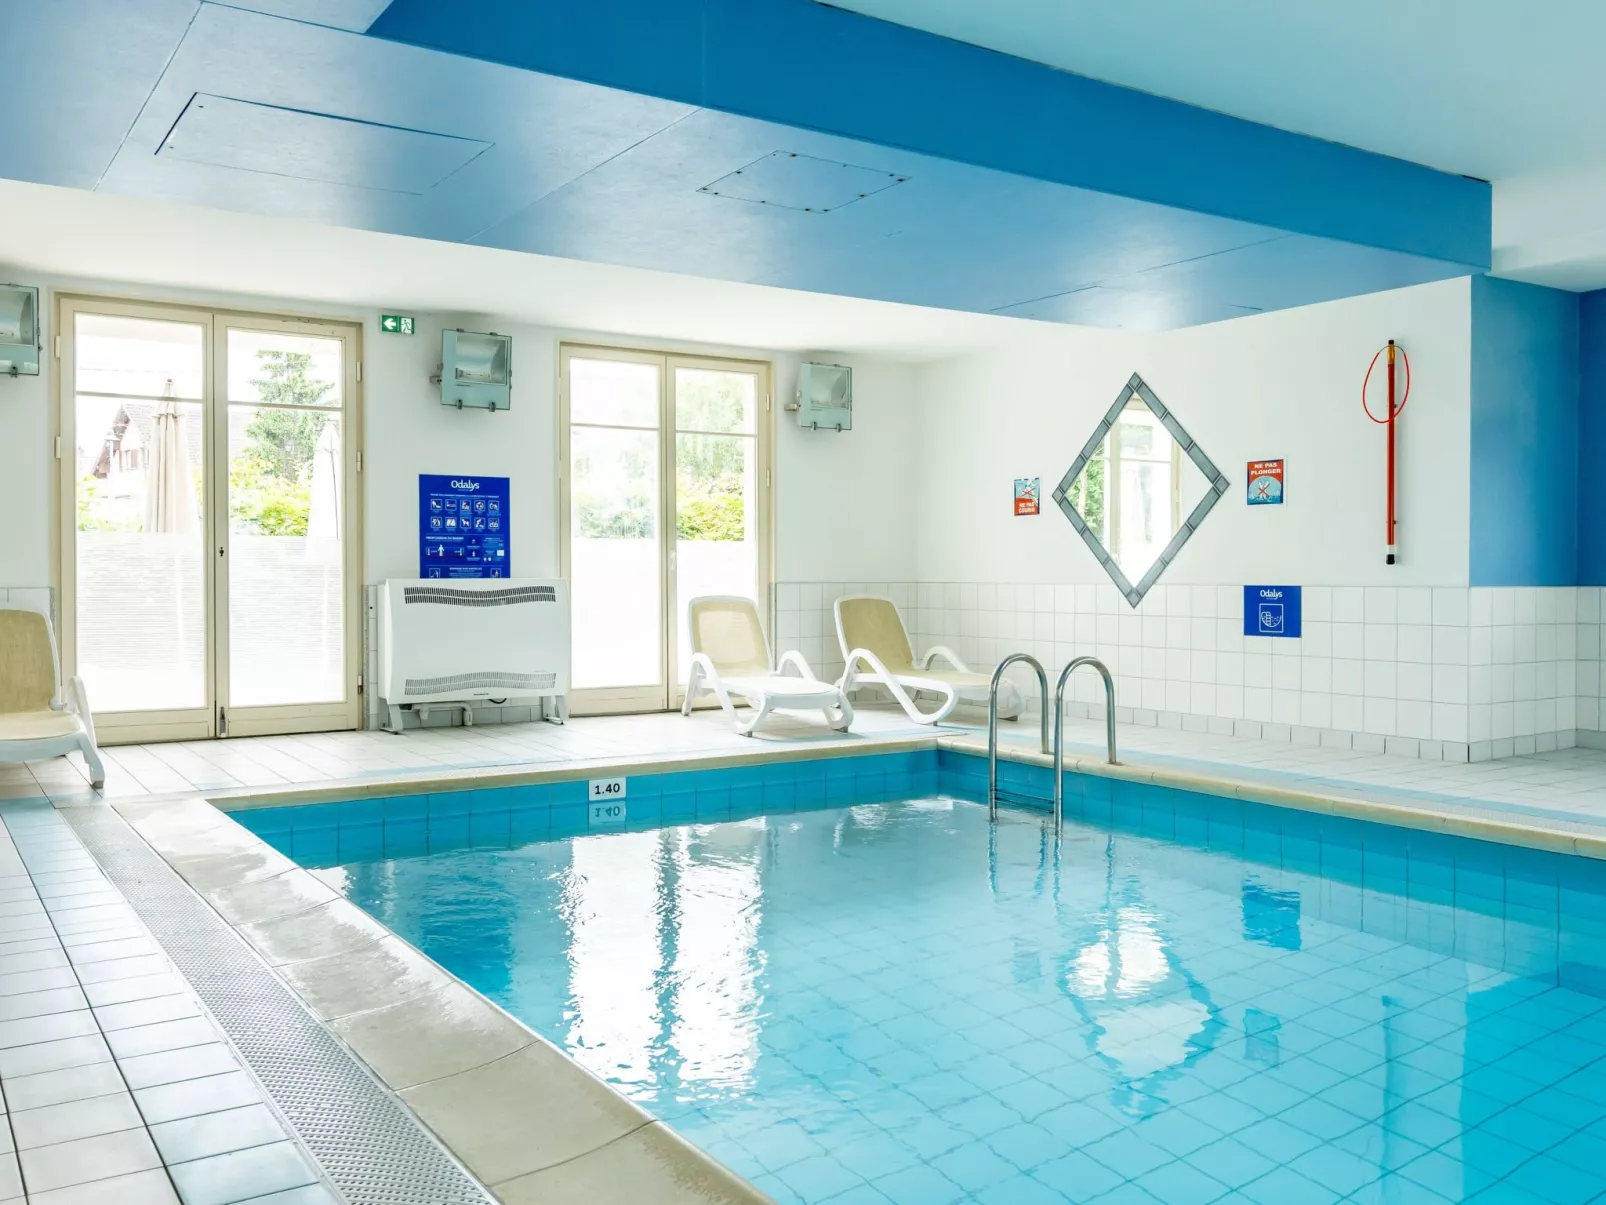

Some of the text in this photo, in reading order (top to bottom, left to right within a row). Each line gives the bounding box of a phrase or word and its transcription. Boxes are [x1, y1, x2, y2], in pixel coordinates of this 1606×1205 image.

[451, 479, 480, 491] Odalys
[1260, 588, 1283, 600] Odalys
[595, 783, 620, 795] 1.40
